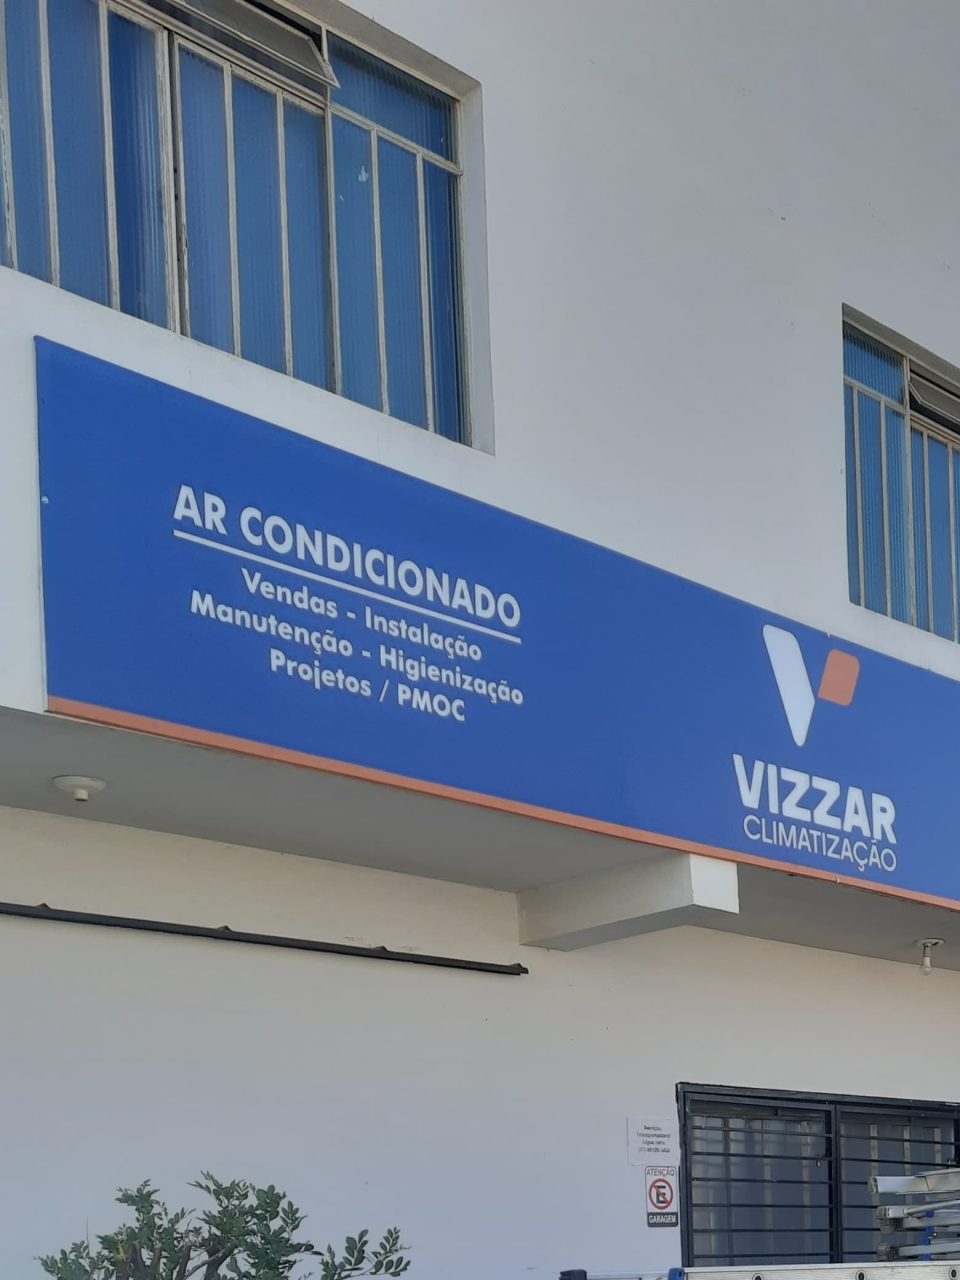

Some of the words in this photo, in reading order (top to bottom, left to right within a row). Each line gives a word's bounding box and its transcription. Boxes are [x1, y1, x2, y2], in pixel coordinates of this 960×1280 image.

[173, 484, 227, 535] AR
[240, 506, 521, 628] CONDICIONADO
[190, 591, 353, 657] Manutenção
[380, 646, 524, 705] Higienização
[241, 568, 338, 618] Vendas
[365, 607, 481, 661] Instalação
[270, 648, 372, 697] Projetos
[398, 685, 466, 721] PMOC
[732, 753, 897, 844] VIZZAR
[744, 814, 897, 872] CLIMATIZAÇÃO
[646, 1167, 675, 1177] ATENÇÃO
[648, 1214, 677, 1224] GARAGEM
